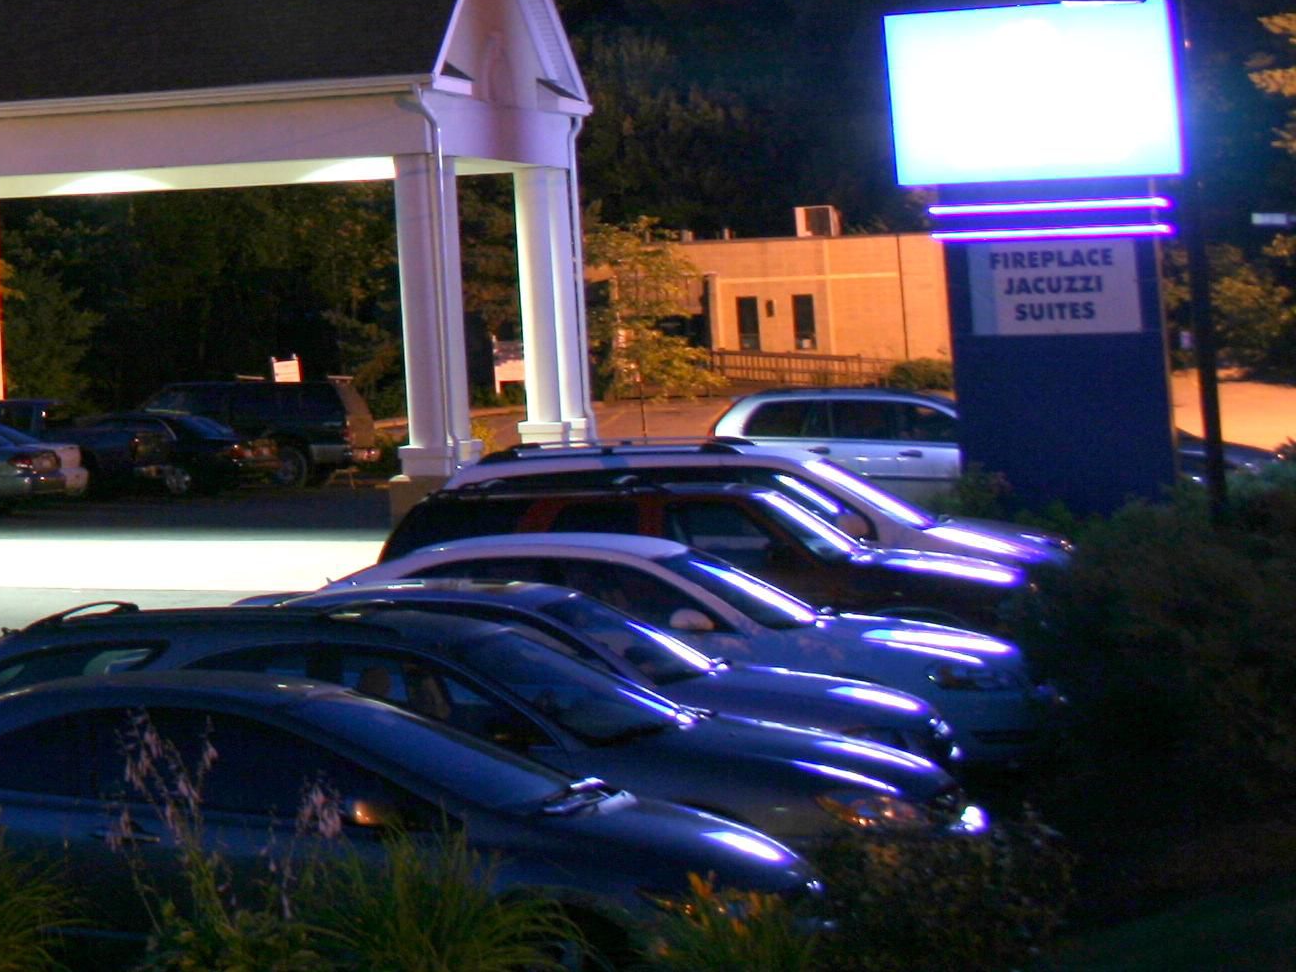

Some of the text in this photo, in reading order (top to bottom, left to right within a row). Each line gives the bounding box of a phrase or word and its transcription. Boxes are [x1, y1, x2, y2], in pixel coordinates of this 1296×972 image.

[989, 248, 1113, 269] FIREPLACE
[1004, 275, 1103, 295] JACUZZI
[1015, 301, 1096, 321] SUITES
